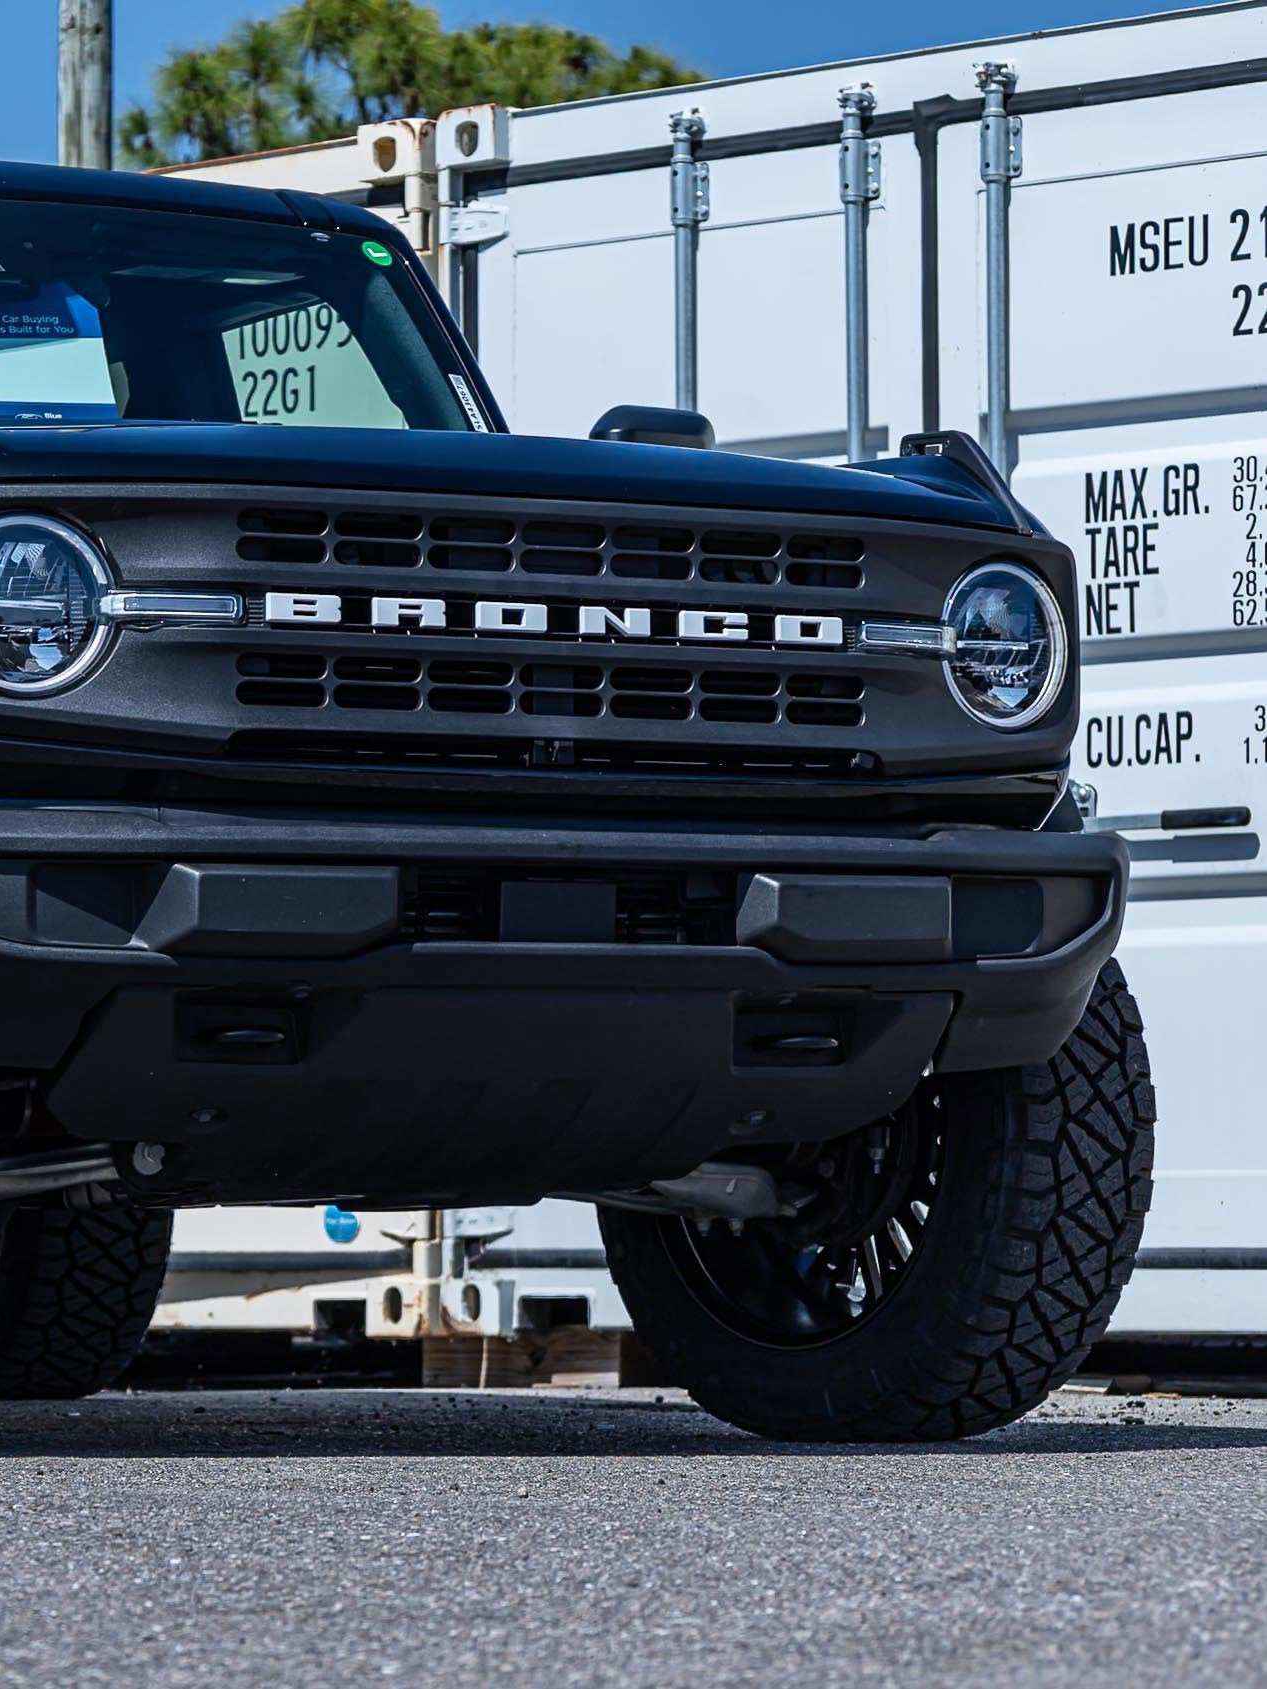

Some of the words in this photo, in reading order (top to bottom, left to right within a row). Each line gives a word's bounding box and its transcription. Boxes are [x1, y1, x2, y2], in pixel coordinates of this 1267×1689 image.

[1109, 213, 1210, 277] MSEU
[1, 314, 19, 323] Car
[22, 314, 59, 325] Buying
[8, 325, 33, 334] Built
[36, 325, 50, 334] for
[53, 325, 75, 334] You
[241, 364, 316, 418] 22G1
[1085, 462, 1210, 524] MAX.GR.
[1233, 455, 1267, 483] 30.
[1233, 484, 1267, 512] 67.
[1085, 523, 1160, 579] TARE
[1246, 541, 1267, 568] 4.
[265, 591, 844, 645] BRONCO
[1085, 580, 1140, 637] NET
[1233, 570, 1267, 598] 28.
[1233, 598, 1267, 627] 62.
[1087, 710, 1202, 769] CU.CAP.
[1254, 704, 1266, 732] 3
